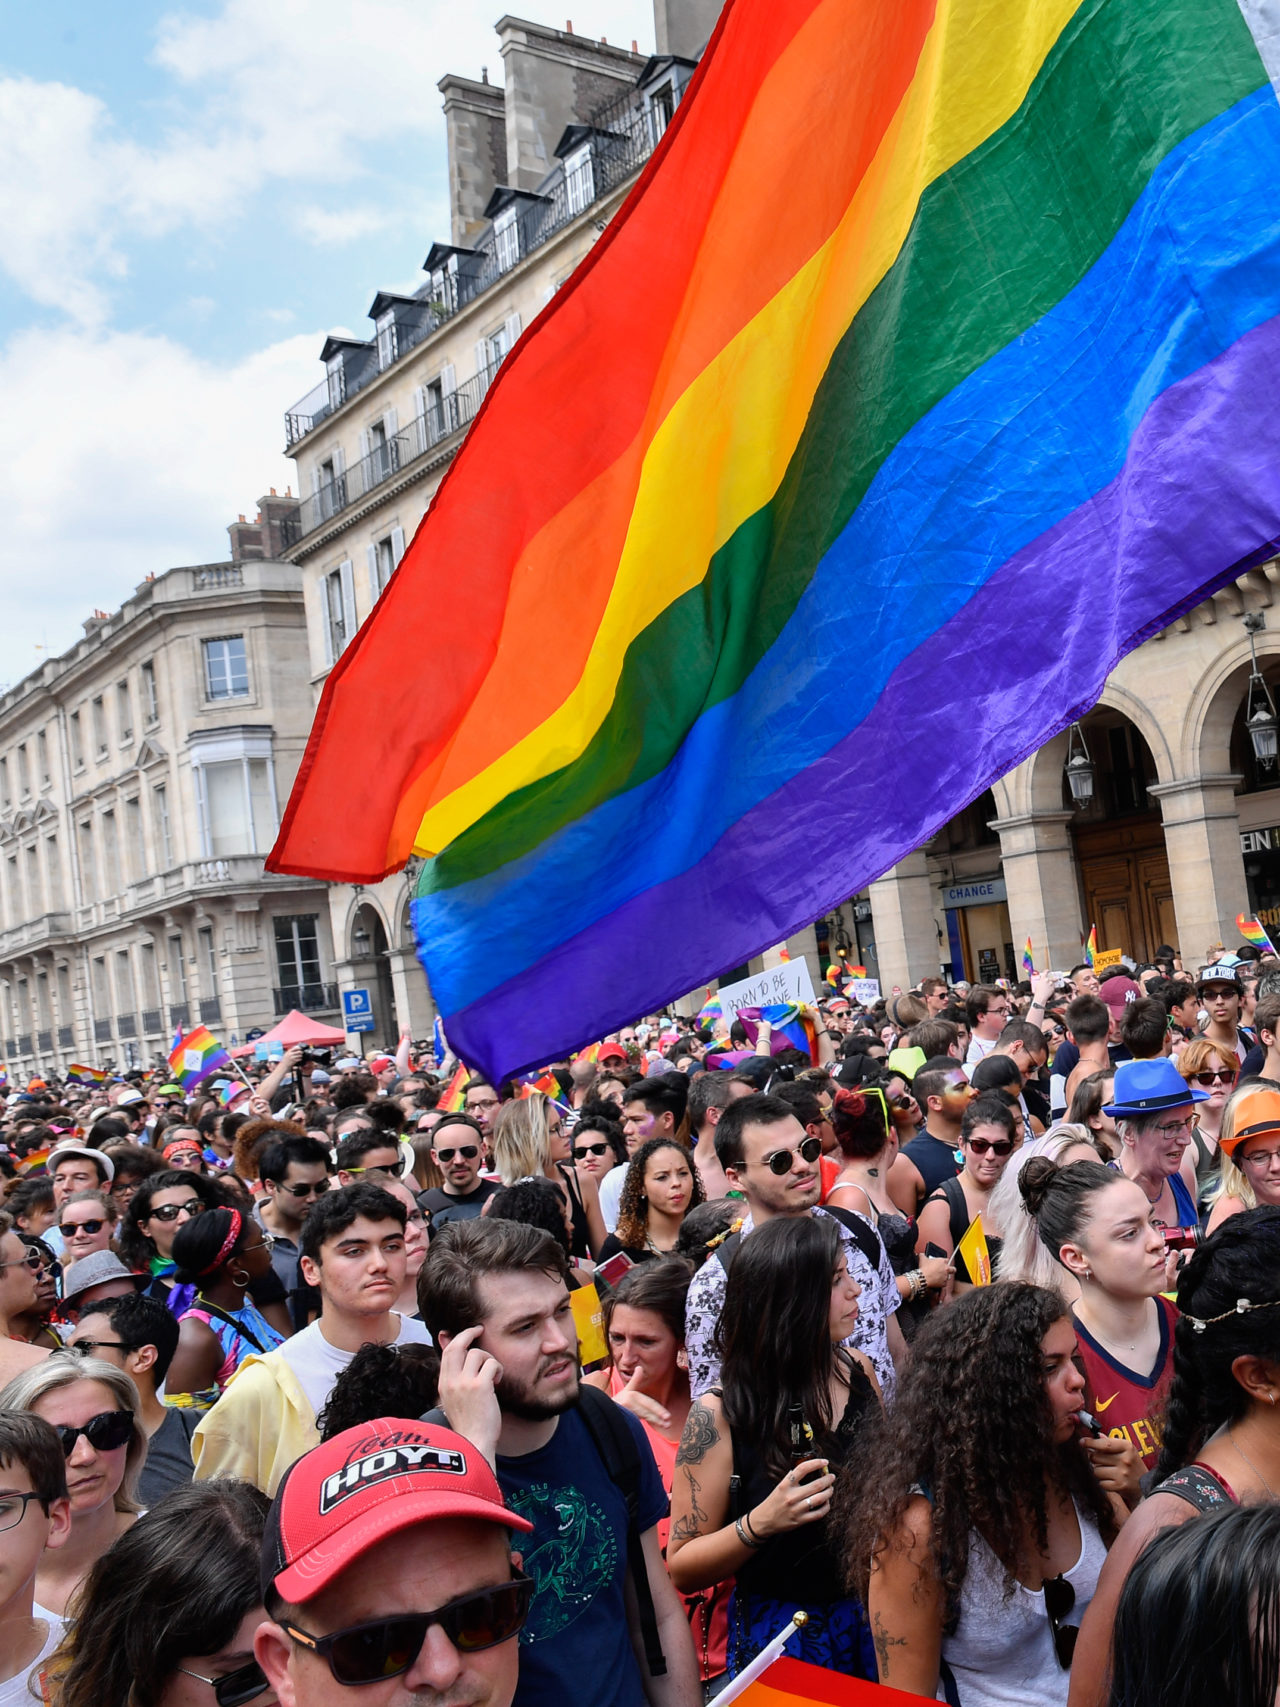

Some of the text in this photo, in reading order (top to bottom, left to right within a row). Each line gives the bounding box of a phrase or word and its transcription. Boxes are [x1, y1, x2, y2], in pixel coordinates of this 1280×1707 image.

[949, 883, 995, 900] CHANGE
[1219, 967, 1236, 980] YORK
[350, 994, 364, 1011] P
[727, 972, 787, 1016] BORN TO BE
[341, 1429, 431, 1471] Team
[326, 1447, 459, 1499] HOYT
[530, 1482, 548, 1491] OLD
[591, 1502, 607, 1521] FOR
